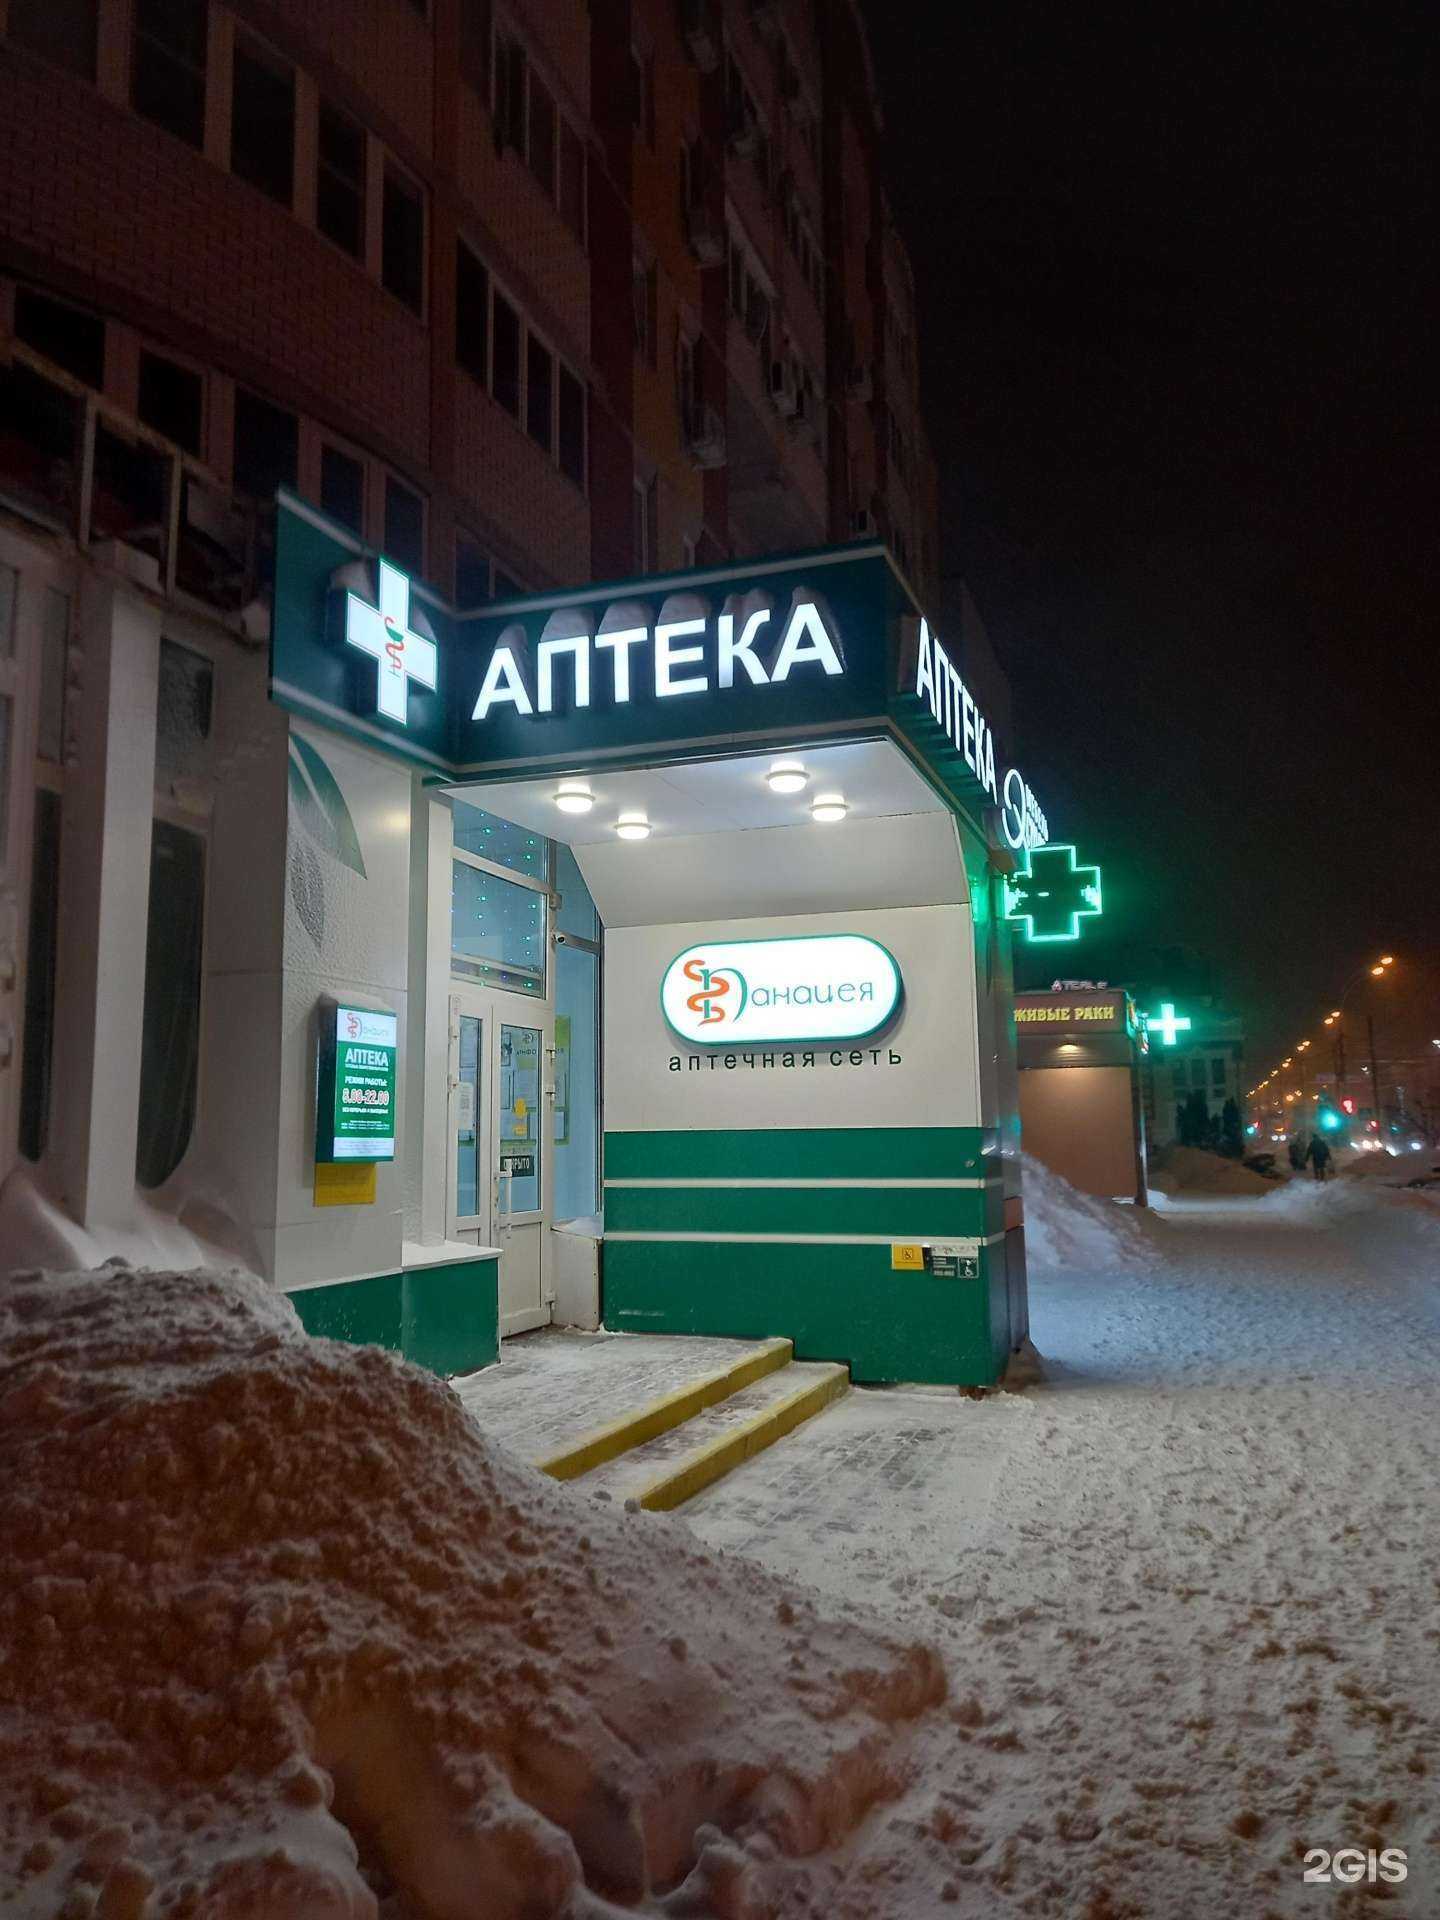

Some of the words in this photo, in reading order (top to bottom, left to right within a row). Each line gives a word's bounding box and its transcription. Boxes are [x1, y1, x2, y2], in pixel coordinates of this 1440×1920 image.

[471, 603, 845, 721] АПТЕКА
[916, 617, 998, 805] АПТЕКА
[1014, 1007, 1071, 1022] ЖИВЫЕ
[1074, 1005, 1115, 1021] РАКИ
[345, 1048, 389, 1066] АПТЕКА
[668, 1051, 815, 1072] аптечная
[829, 1048, 902, 1067] сеть
